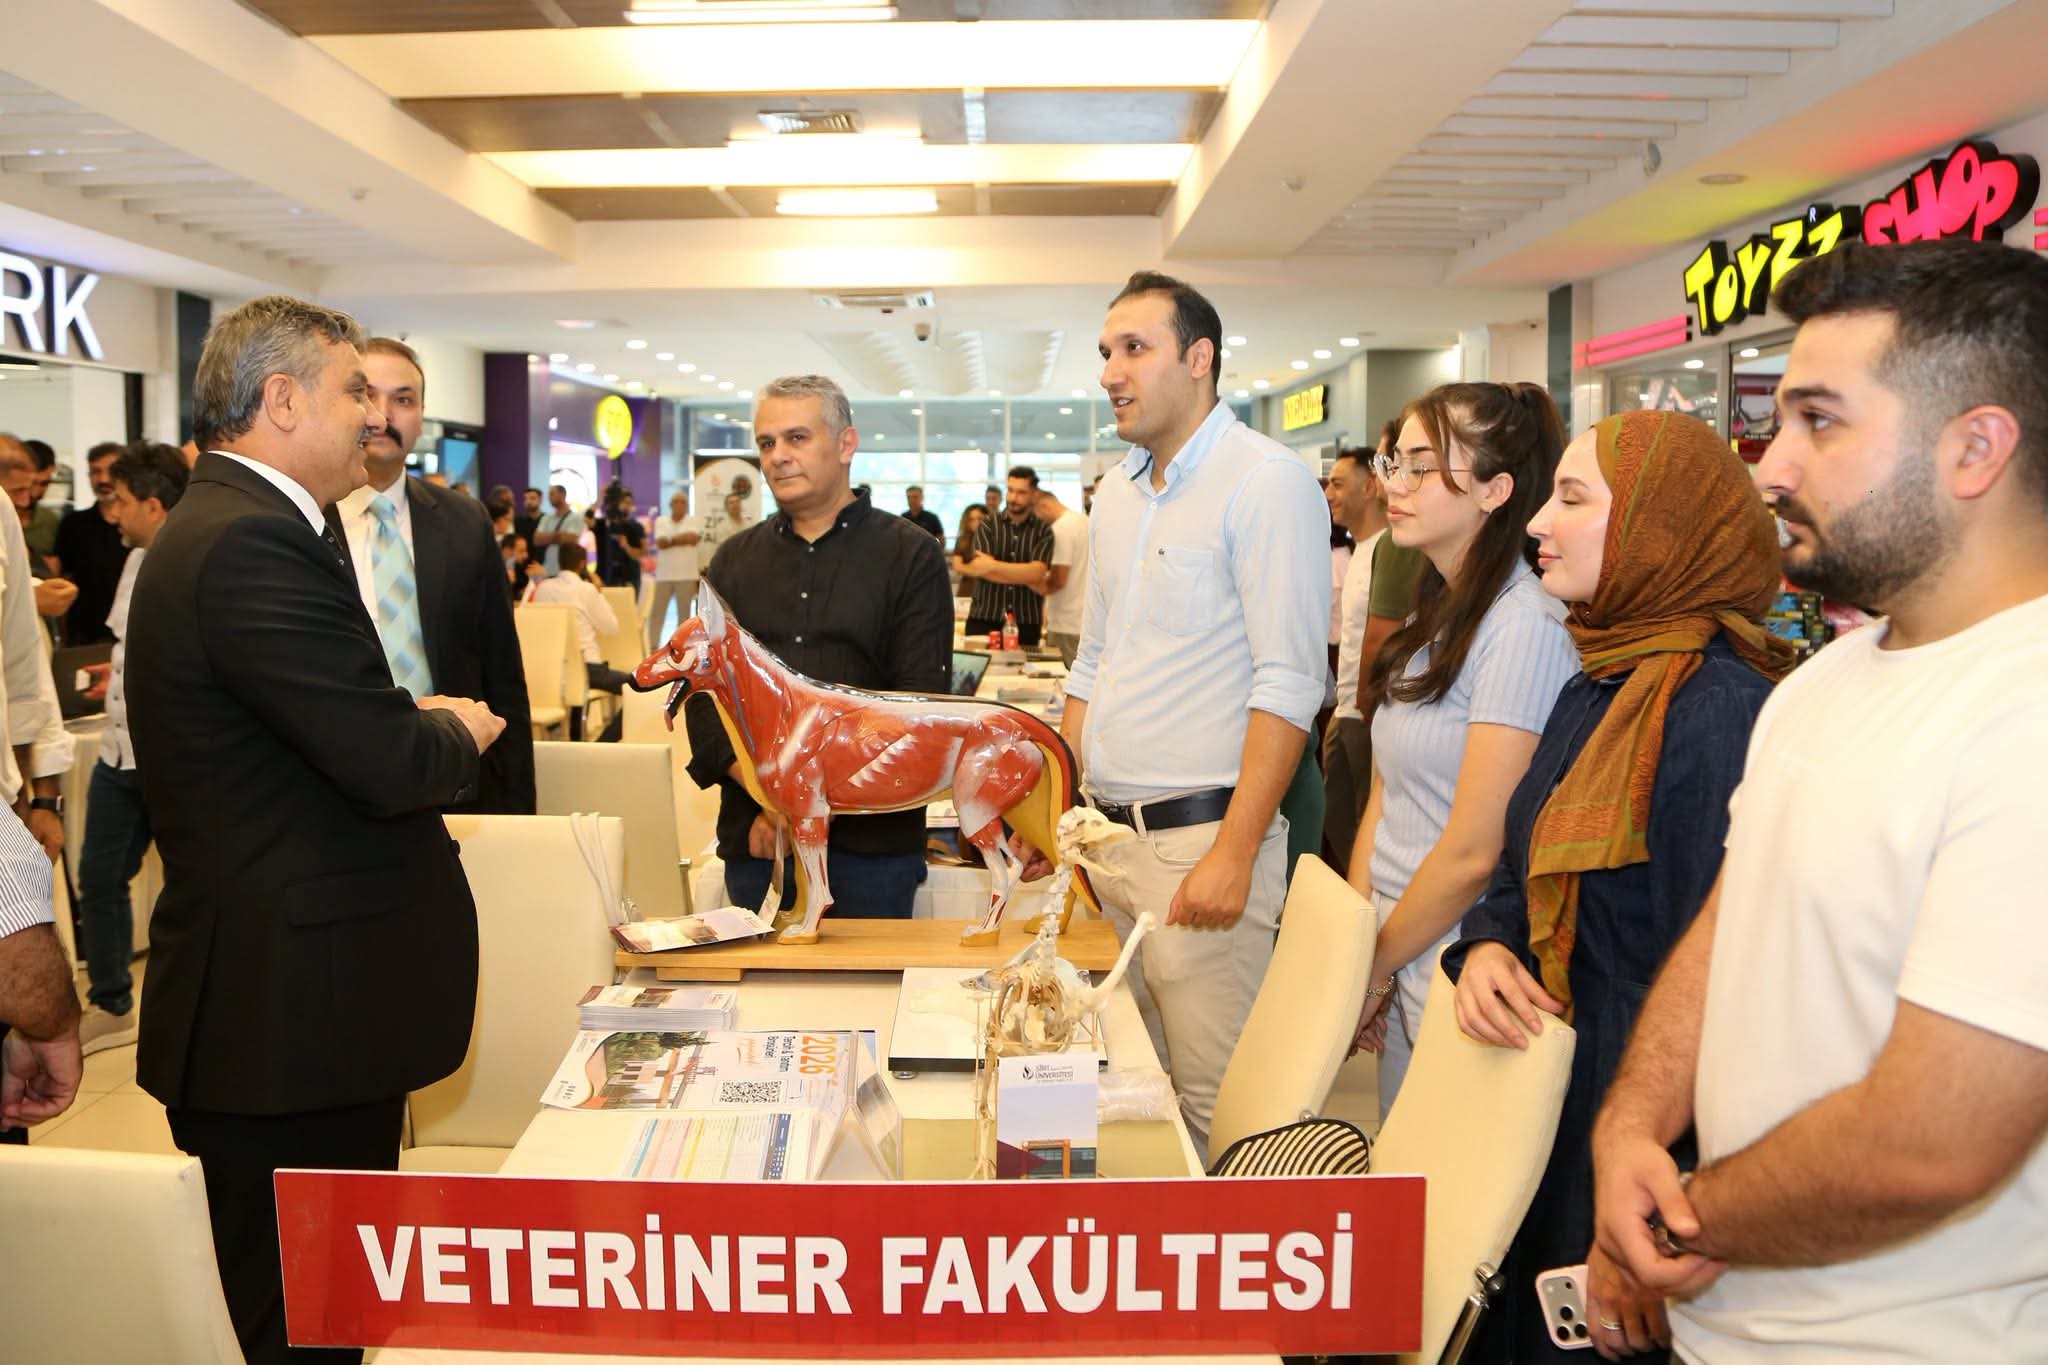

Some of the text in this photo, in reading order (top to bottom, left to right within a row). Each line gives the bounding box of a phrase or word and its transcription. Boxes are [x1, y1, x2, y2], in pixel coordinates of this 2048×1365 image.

[0, 250, 104, 361] RK
[782, 1036, 796, 1050] Tercih
[799, 1036, 838, 1075] 2026
[357, 1213, 1354, 1314] VETERİNER FAKÜLTESİ
